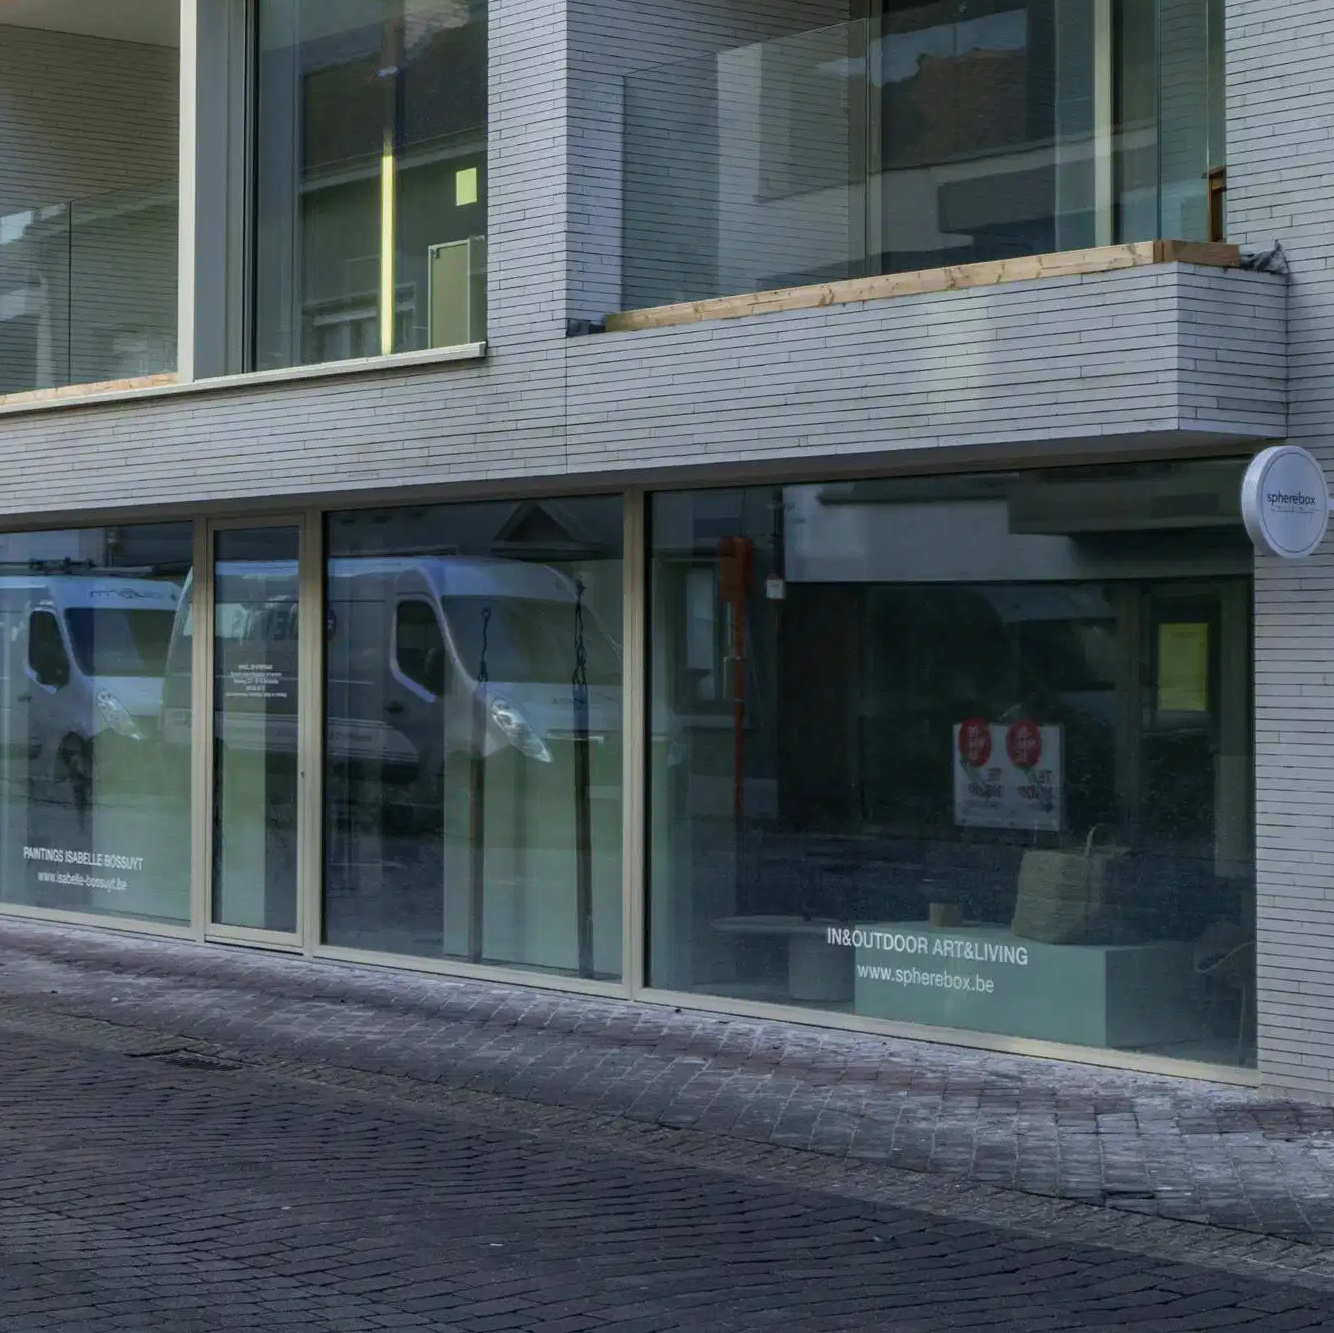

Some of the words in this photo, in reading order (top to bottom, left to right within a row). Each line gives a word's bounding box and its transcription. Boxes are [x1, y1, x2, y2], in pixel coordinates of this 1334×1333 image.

[1267, 490, 1316, 506] spherebox
[23, 846, 64, 863] PAINTINGS
[65, 850, 104, 866] ISABELLE
[105, 854, 144, 870] BOSSUYT
[827, 927, 928, 955] IN&OUTDOOR
[932, 938, 1028, 966] ART&LIVING
[857, 964, 994, 993] www.spherebox.be
